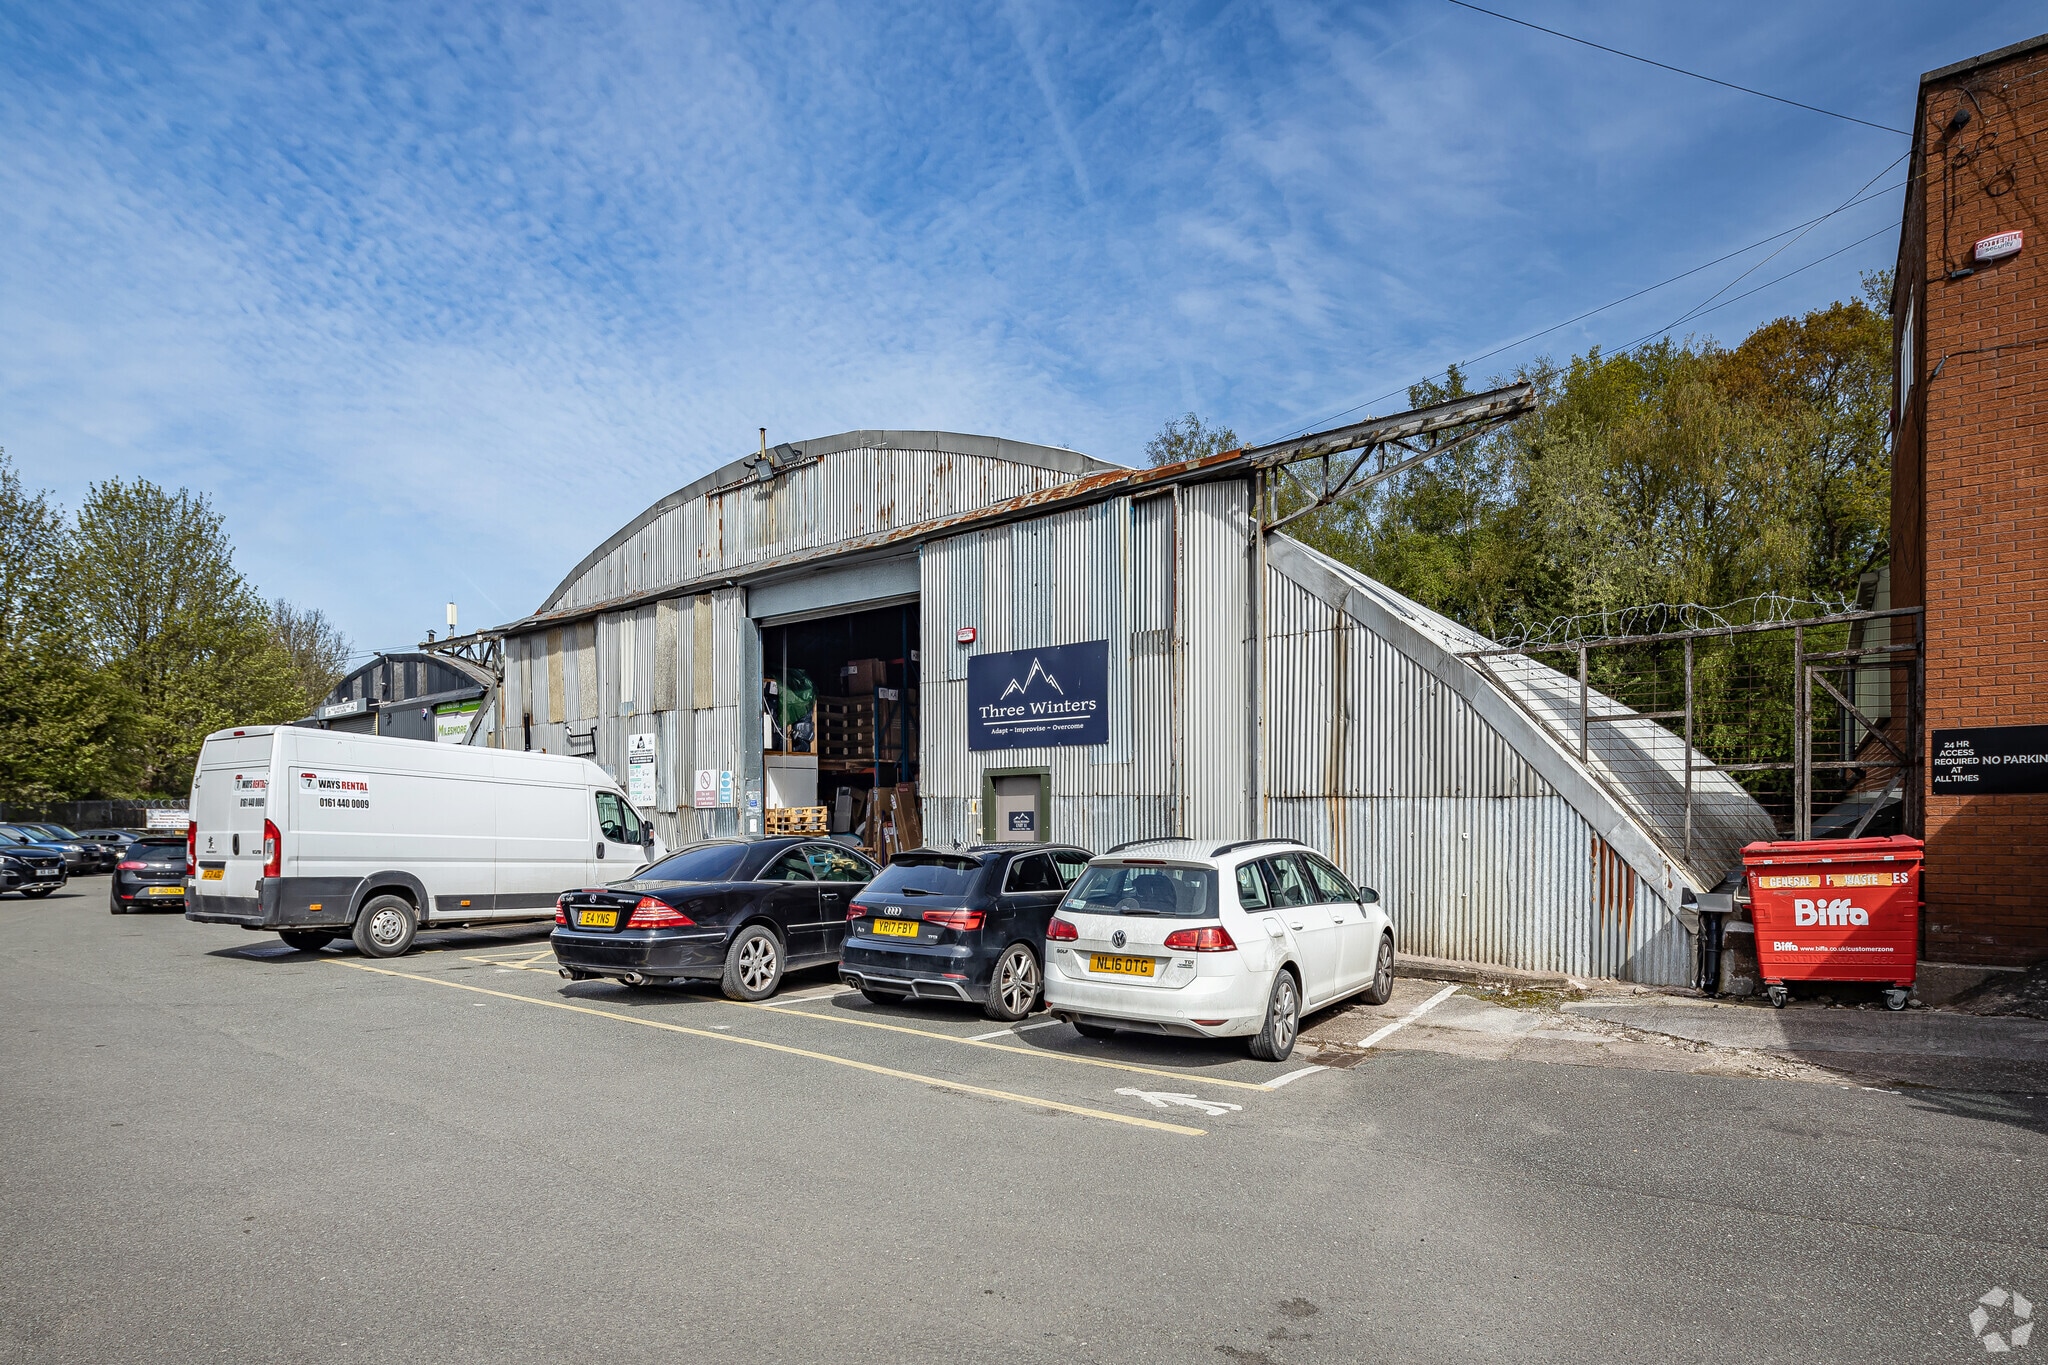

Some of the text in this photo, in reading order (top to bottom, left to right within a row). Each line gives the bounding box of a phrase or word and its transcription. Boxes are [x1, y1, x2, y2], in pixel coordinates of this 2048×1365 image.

[1977, 233, 2019, 249] COTTERILL
[1985, 241, 2014, 252] security
[979, 699, 1097, 719] Three Winters
[991, 727, 1009, 735] Adapt
[1014, 725, 1046, 734] Improvise
[1052, 722, 1084, 731] Overcome
[1956, 740, 1970, 748] HR
[1939, 749, 1975, 757] ACCESS
[1934, 757, 1980, 766] REQUIRED
[1982, 754, 2048, 765] NO PARKIN
[1951, 766, 1963, 774] AT
[1934, 774, 1980, 783] ALL TIMES
[306, 779, 368, 791] 7 WAYS RENTAL
[320, 797, 369, 808] 0161 440 0009
[1769, 876, 1811, 888] GENERAL
[1845, 873, 1879, 886] WASTE
[585, 912, 611, 924] E4 YNS
[1794, 898, 1869, 926] Biffa
[879, 920, 914, 934] YR17 FBY
[1773, 941, 1895, 953] Biffa www.biffa.co.uk/customerzone
[1096, 956, 1149, 973] NL16 OTG
